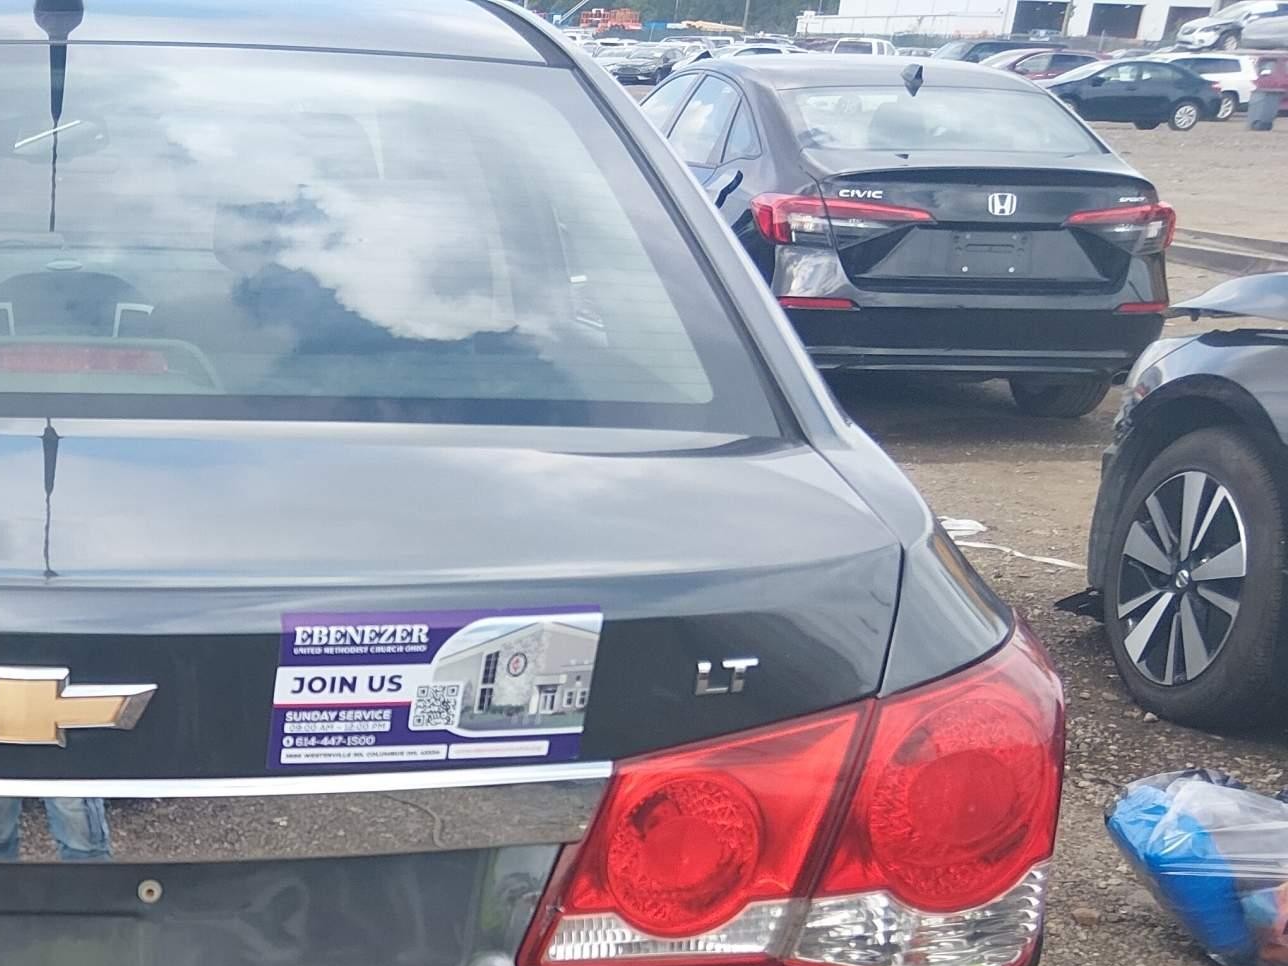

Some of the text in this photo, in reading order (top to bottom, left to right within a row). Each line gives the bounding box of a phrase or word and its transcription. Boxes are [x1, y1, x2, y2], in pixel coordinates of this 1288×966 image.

[838, 189, 884, 199] CIVIC
[293, 624, 430, 646] EBENEZER
[293, 646, 322, 655] UNITED
[370, 645, 403, 654] CHURCH
[695, 658, 760, 696] LT
[291, 674, 404, 695] JOIN US
[285, 708, 393, 722] SUNDAY SERVICE
[295, 735, 376, 747] 614-447-1500
